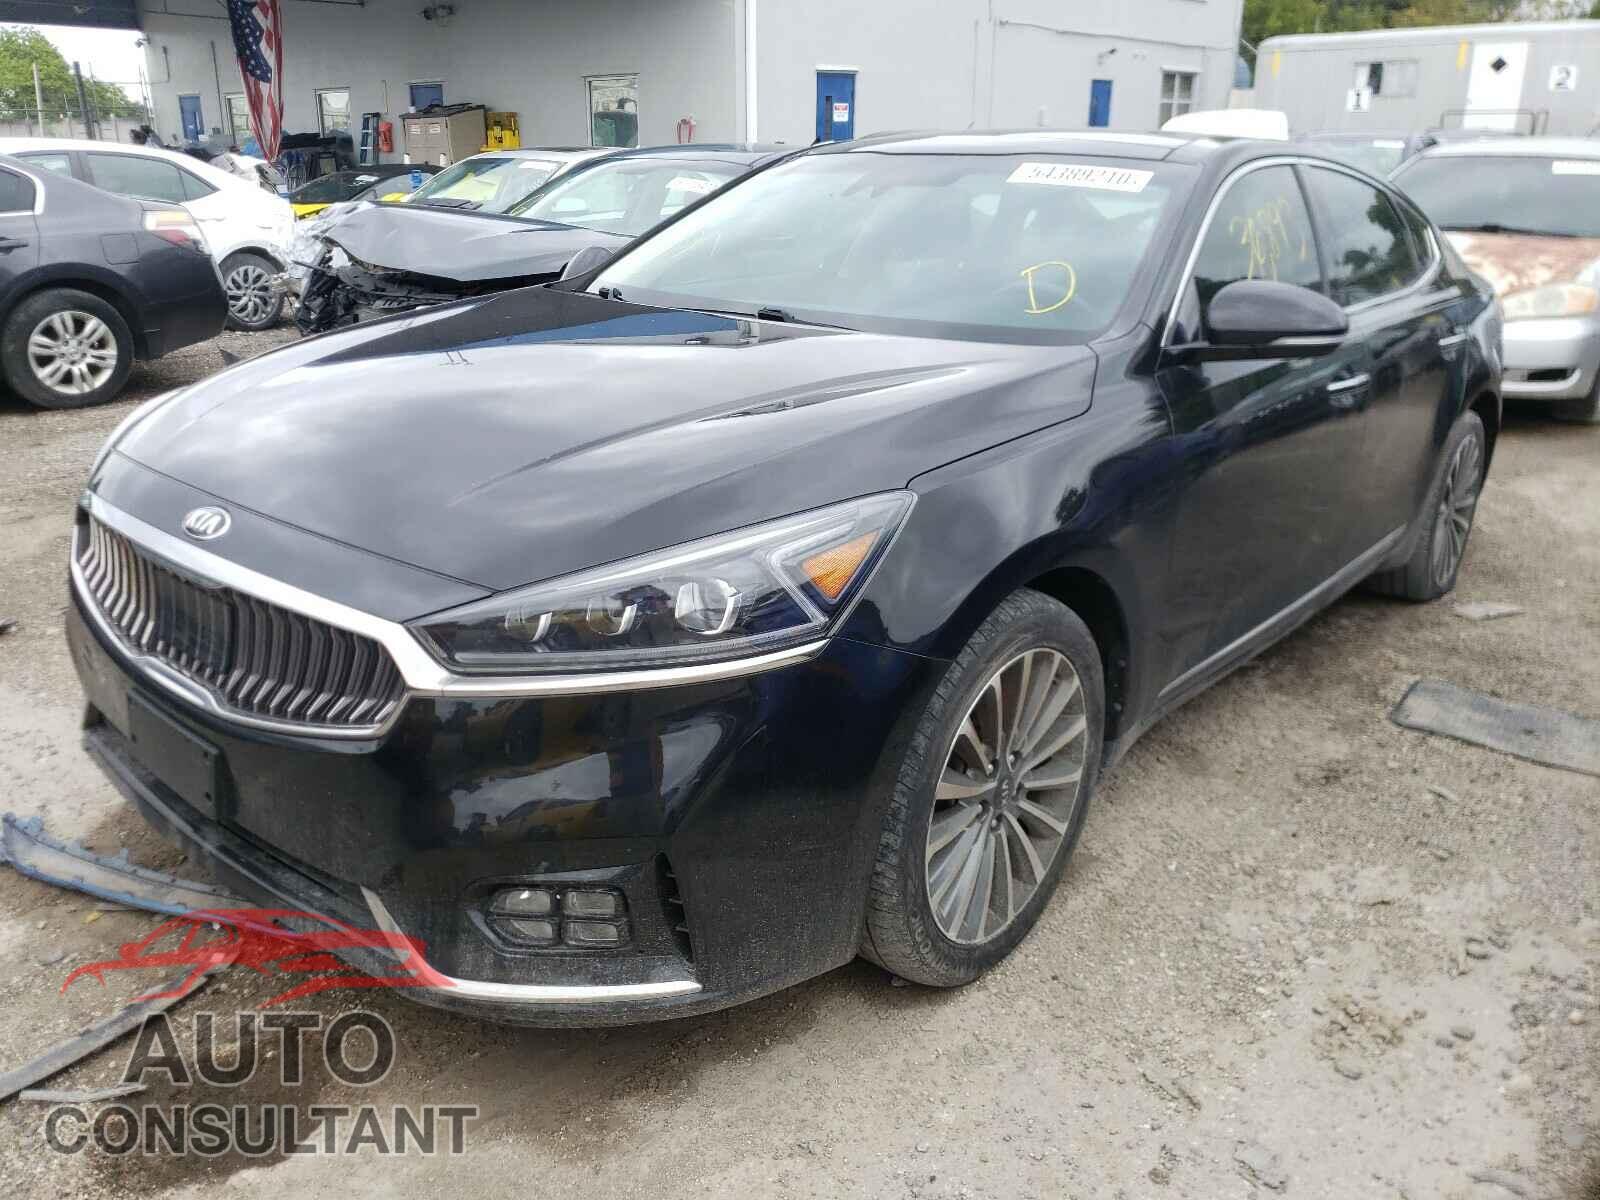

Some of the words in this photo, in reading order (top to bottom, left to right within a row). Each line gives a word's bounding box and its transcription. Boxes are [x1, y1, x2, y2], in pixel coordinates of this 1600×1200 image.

[1554, 66, 1571, 89] 2
[1021, 261, 1076, 314] D
[187, 509, 227, 536] KIA
